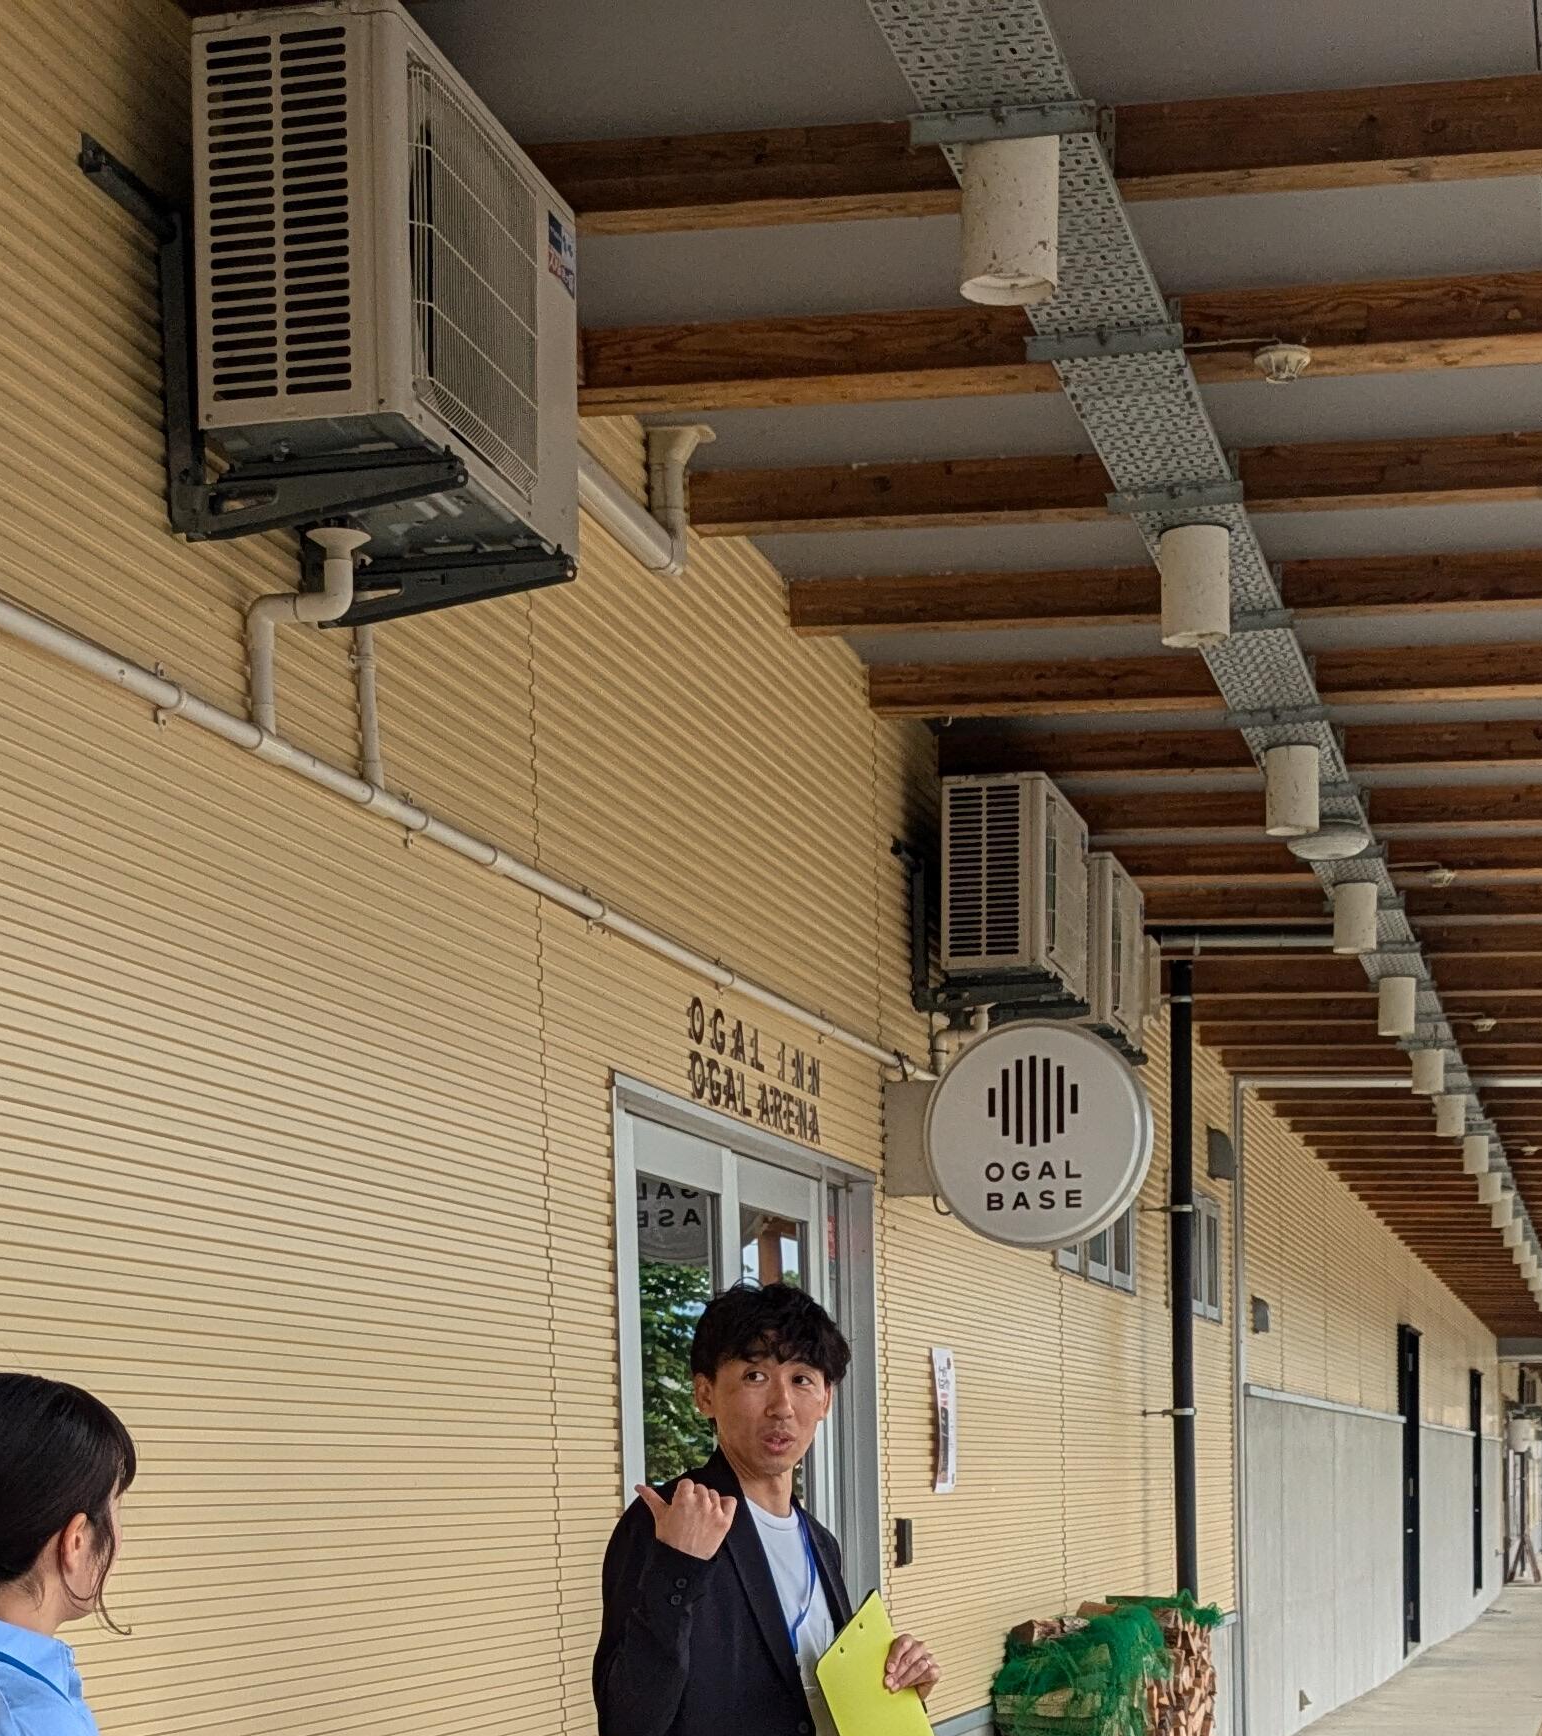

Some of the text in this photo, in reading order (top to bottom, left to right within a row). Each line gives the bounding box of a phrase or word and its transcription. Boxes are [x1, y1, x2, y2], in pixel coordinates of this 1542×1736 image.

[688, 996, 821, 1098] OGAL INN
[689, 1050, 821, 1146] OGAL ARENA
[985, 1160, 1082, 1182] OGAL
[986, 1189, 1082, 1211] BASE
